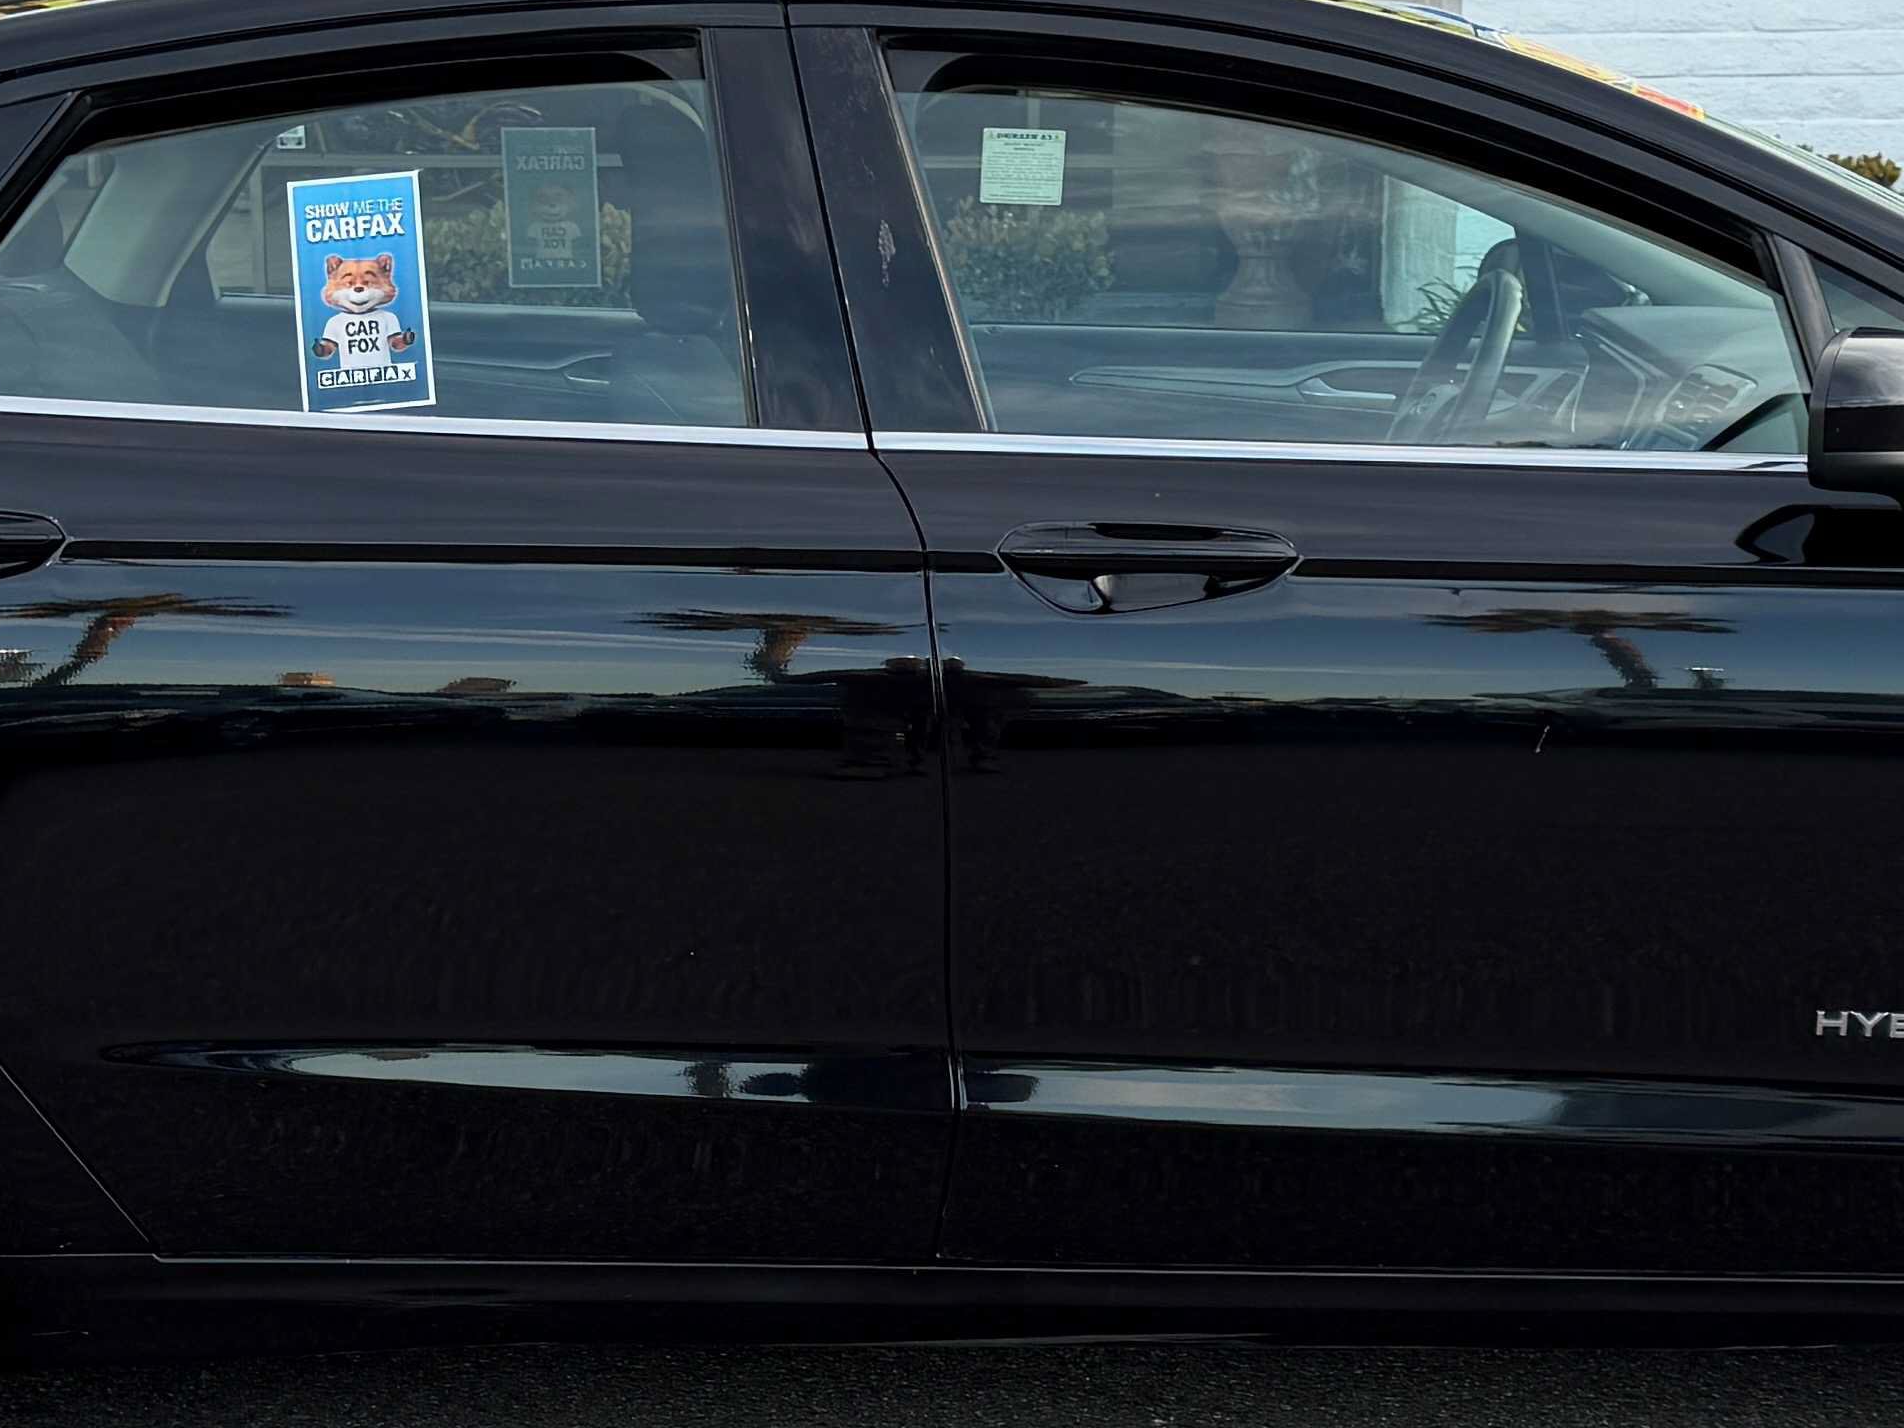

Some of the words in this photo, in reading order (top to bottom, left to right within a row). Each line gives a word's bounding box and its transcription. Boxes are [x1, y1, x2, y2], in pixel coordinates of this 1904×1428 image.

[304, 202, 350, 220] SHOW
[352, 199, 374, 214] ME
[377, 196, 404, 212] THE
[306, 212, 406, 243] CARFAX
[345, 320, 380, 338] CAR
[347, 337, 381, 355] FOX
[318, 365, 413, 387] CARFAX
